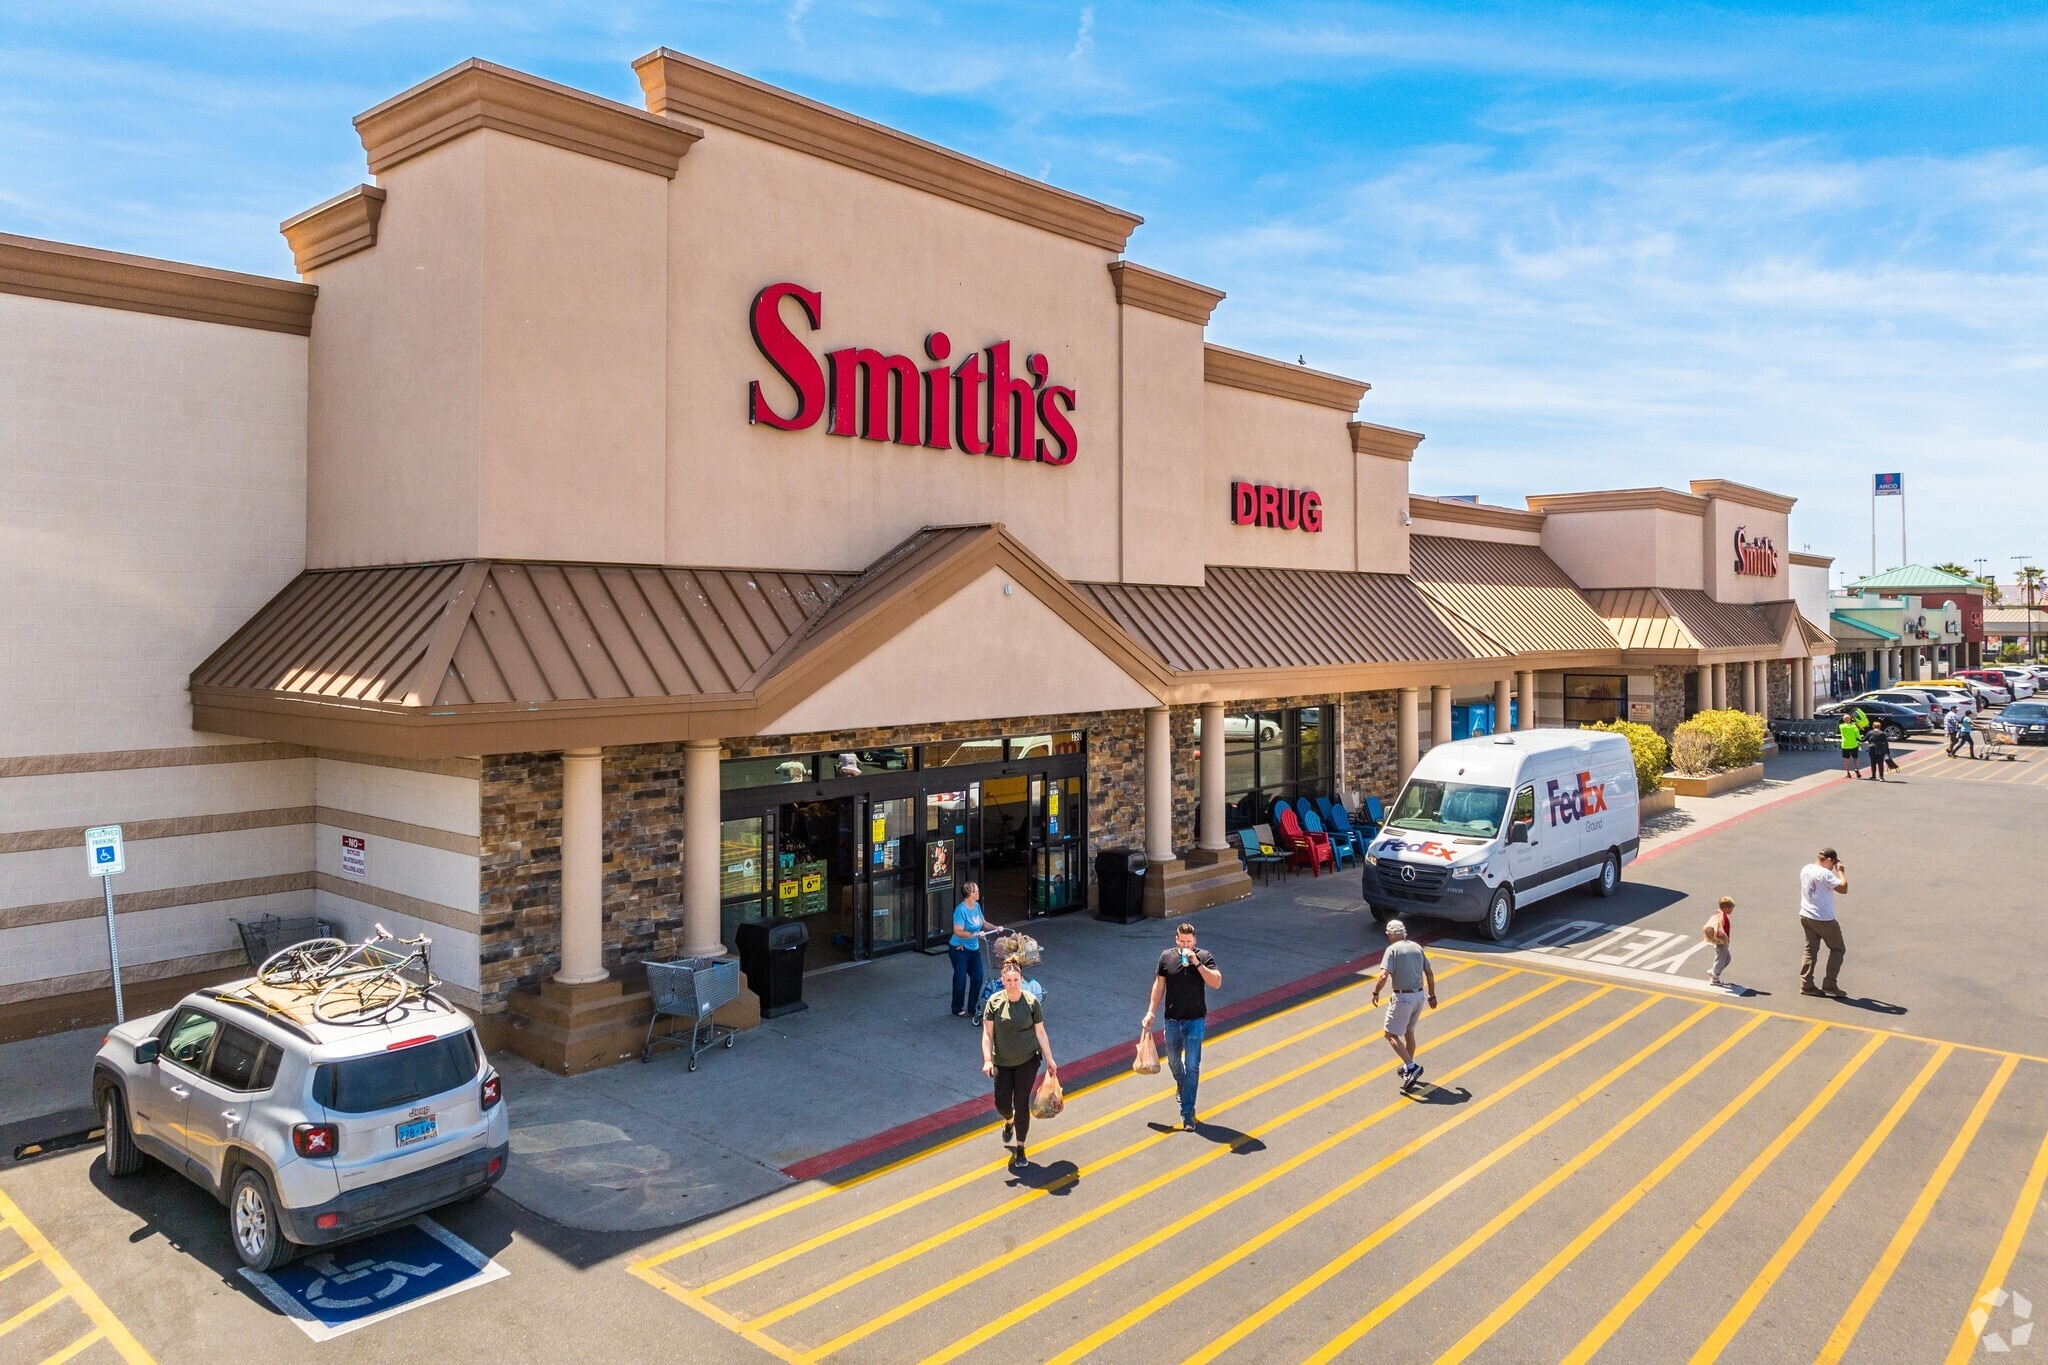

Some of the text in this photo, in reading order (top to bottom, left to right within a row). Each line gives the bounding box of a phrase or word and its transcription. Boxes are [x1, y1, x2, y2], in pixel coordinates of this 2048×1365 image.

[749, 282, 1078, 466] Smith's
[1231, 481, 1322, 533] DRUG
[1734, 528, 1779, 577] Smith's
[1546, 770, 1608, 828] FedEx
[88, 828, 119, 839] RESERVED
[92, 837, 117, 846] PARKING
[1585, 819, 1603, 833] Ground
[1378, 838, 1458, 862] FedEx
[1518, 919, 1711, 975] YIELD
[409, 1105, 431, 1118] Jeep
